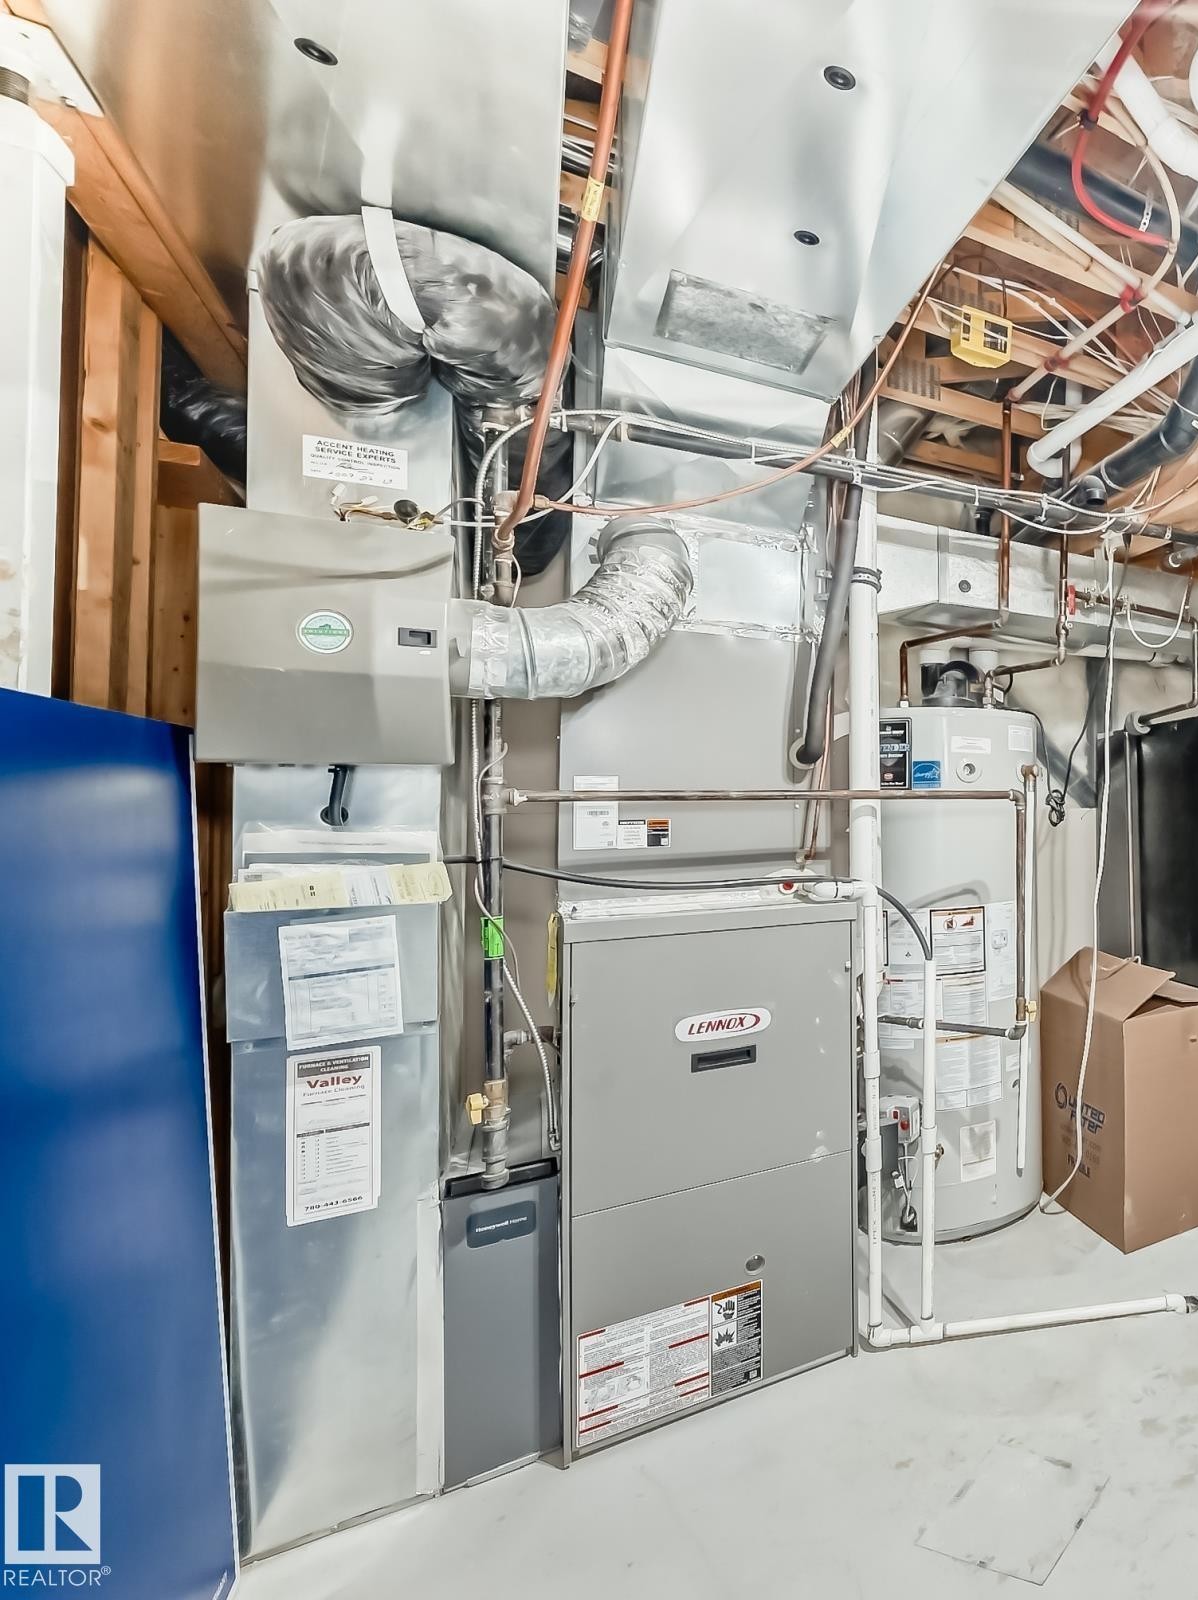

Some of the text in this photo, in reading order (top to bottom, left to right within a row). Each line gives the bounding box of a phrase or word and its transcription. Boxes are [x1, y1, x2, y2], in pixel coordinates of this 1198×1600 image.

[315, 446, 397, 464] SERVICE EXPERTS
[316, 439, 394, 457] ACCENT HEATING
[687, 1015, 747, 1035] LENNOX
[299, 1061, 327, 1070] FURNACE
[332, 1056, 369, 1065] VENTILATION
[302, 1084, 365, 1097] Furnace Cleaning
[306, 1075, 362, 1090] Valley
[475, 1216, 528, 1233] Honeywell Home
